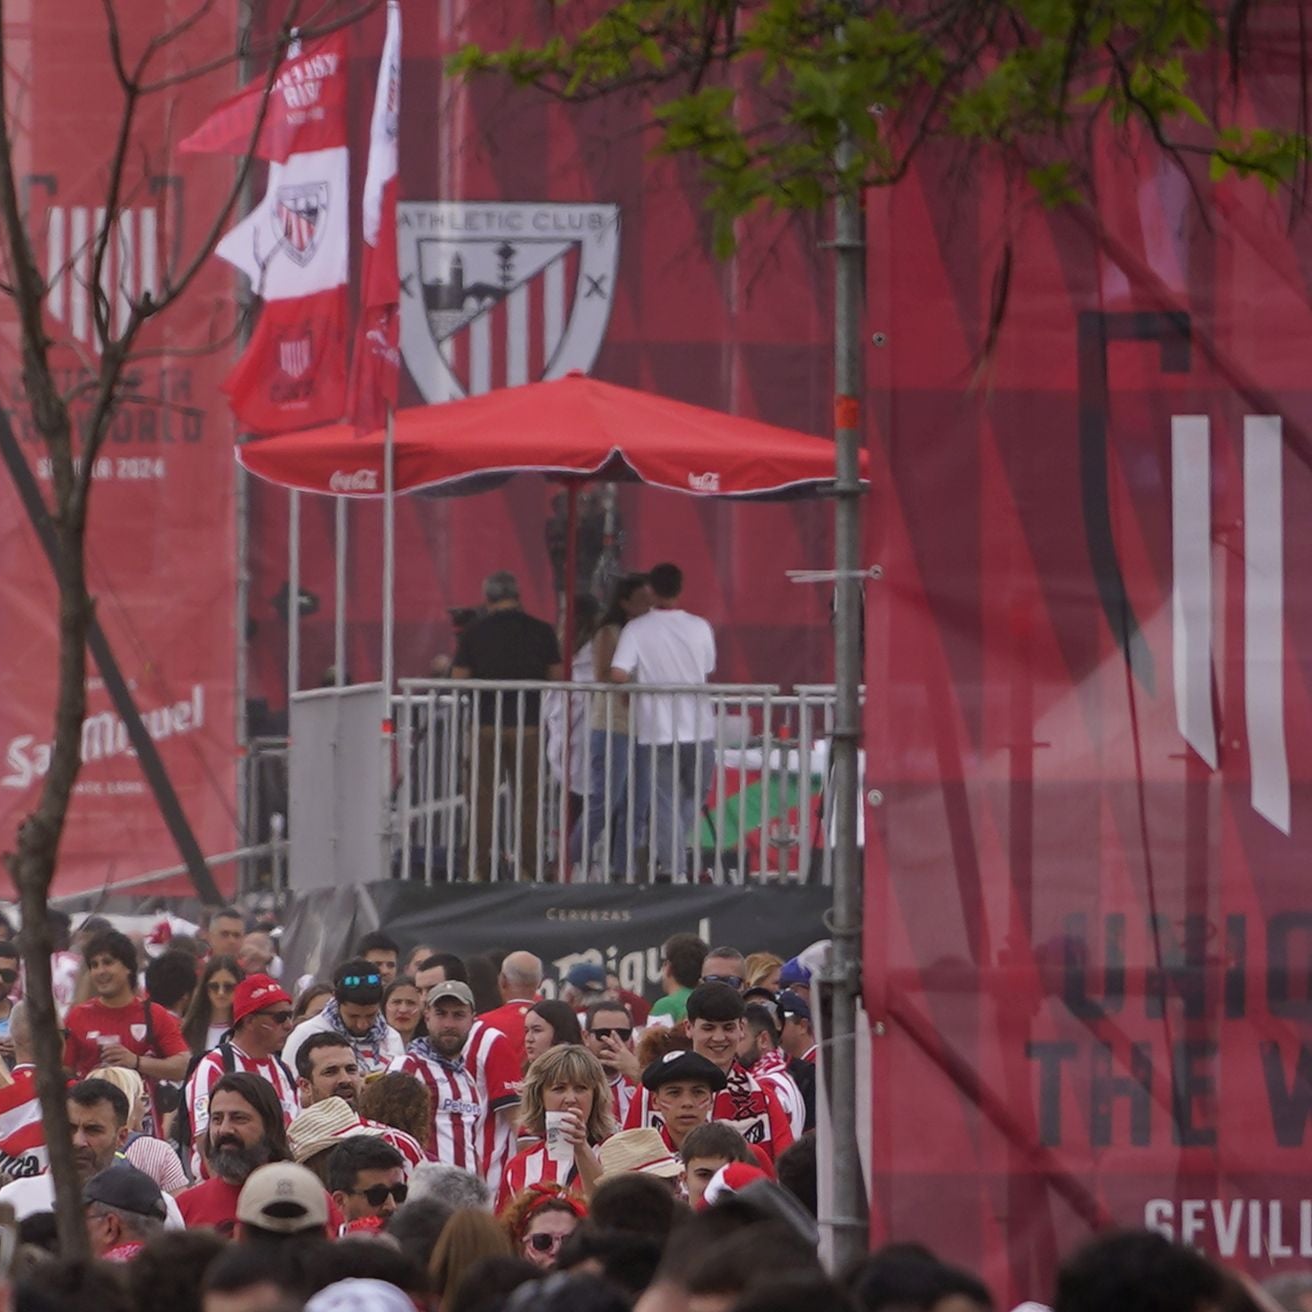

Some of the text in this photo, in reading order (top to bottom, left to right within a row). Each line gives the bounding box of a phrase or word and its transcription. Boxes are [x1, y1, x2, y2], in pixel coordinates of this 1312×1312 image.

[398, 209, 603, 231] ATHLETIC CLUB
[117, 456, 165, 478] 2024
[0, 684, 204, 789] Sa Miuel
[1026, 1040, 1216, 1149] THE
